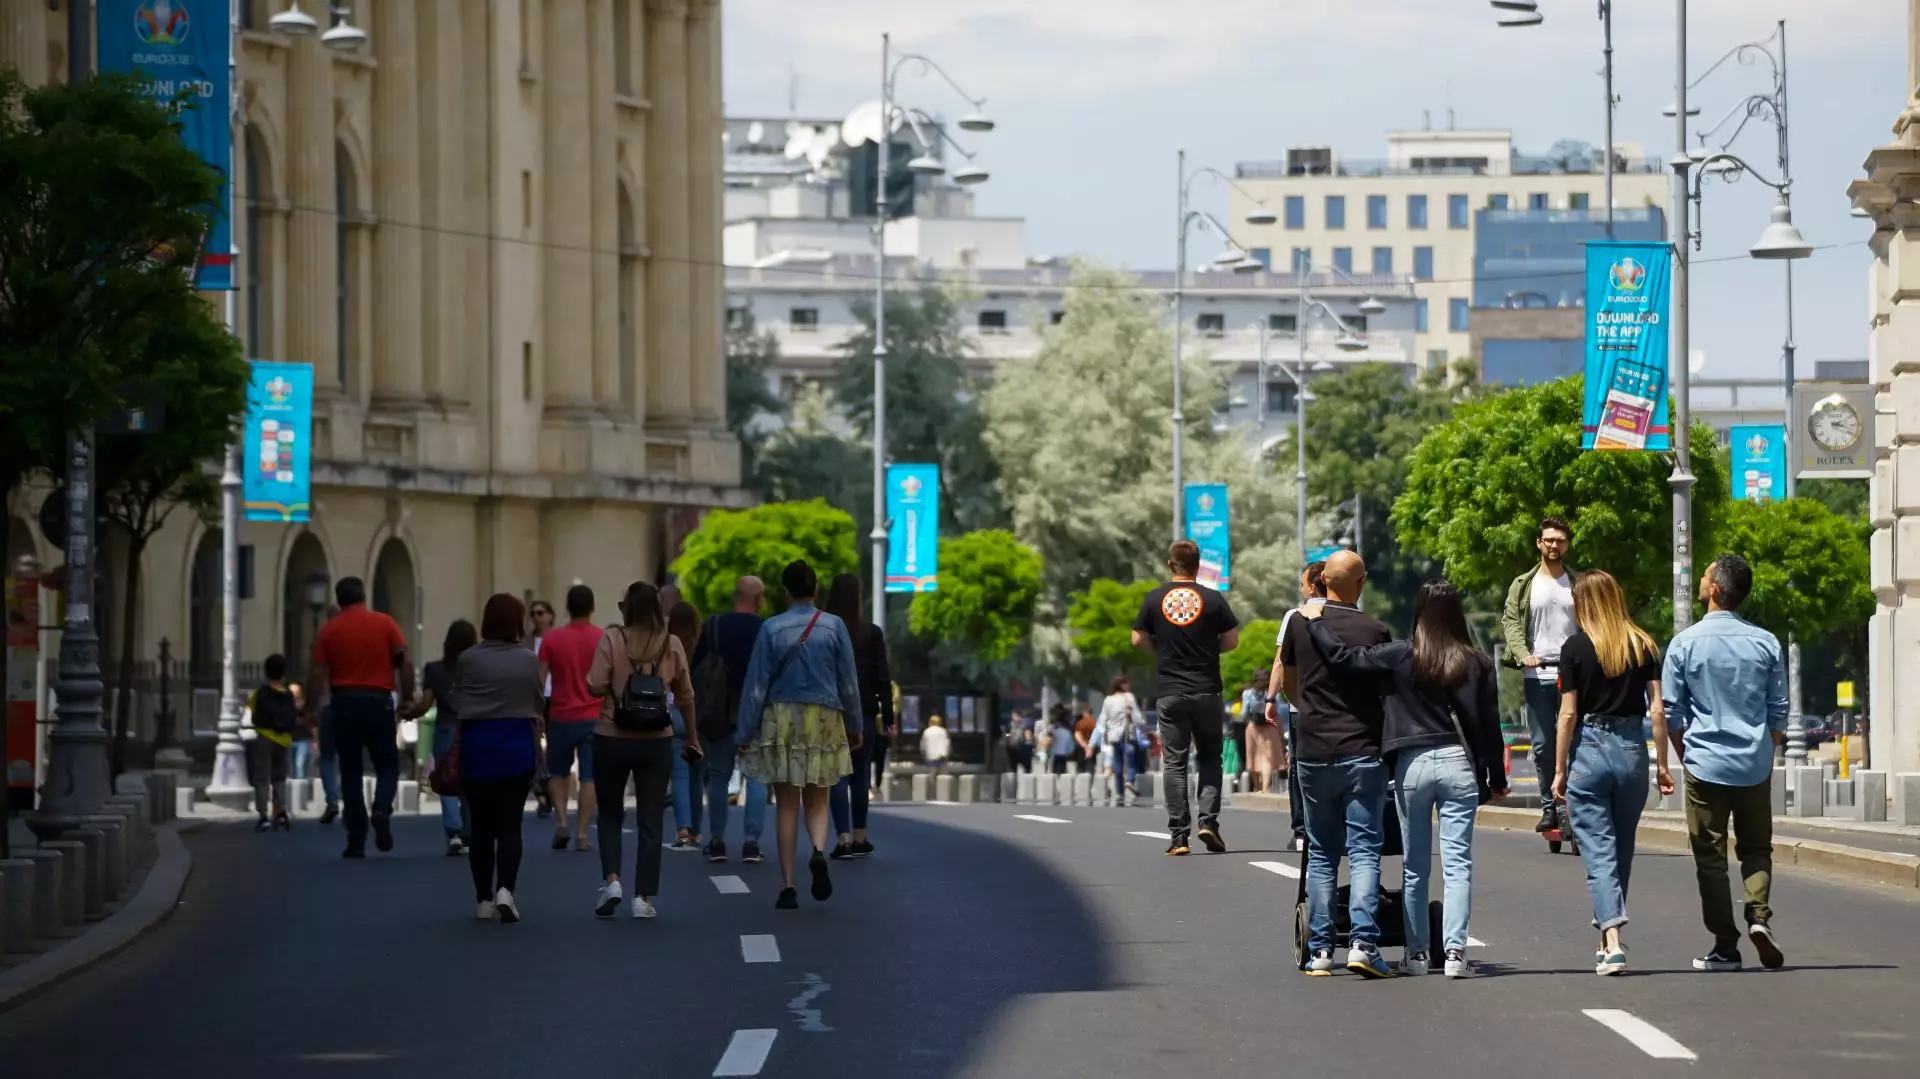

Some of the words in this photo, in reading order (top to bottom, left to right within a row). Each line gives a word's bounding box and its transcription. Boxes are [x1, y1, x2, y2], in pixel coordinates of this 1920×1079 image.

[1596, 312, 1660, 324] DOWNLOAD
[1596, 326, 1618, 337] THE
[1619, 326, 1642, 337] APP
[1816, 456, 1854, 465] ROLEX
